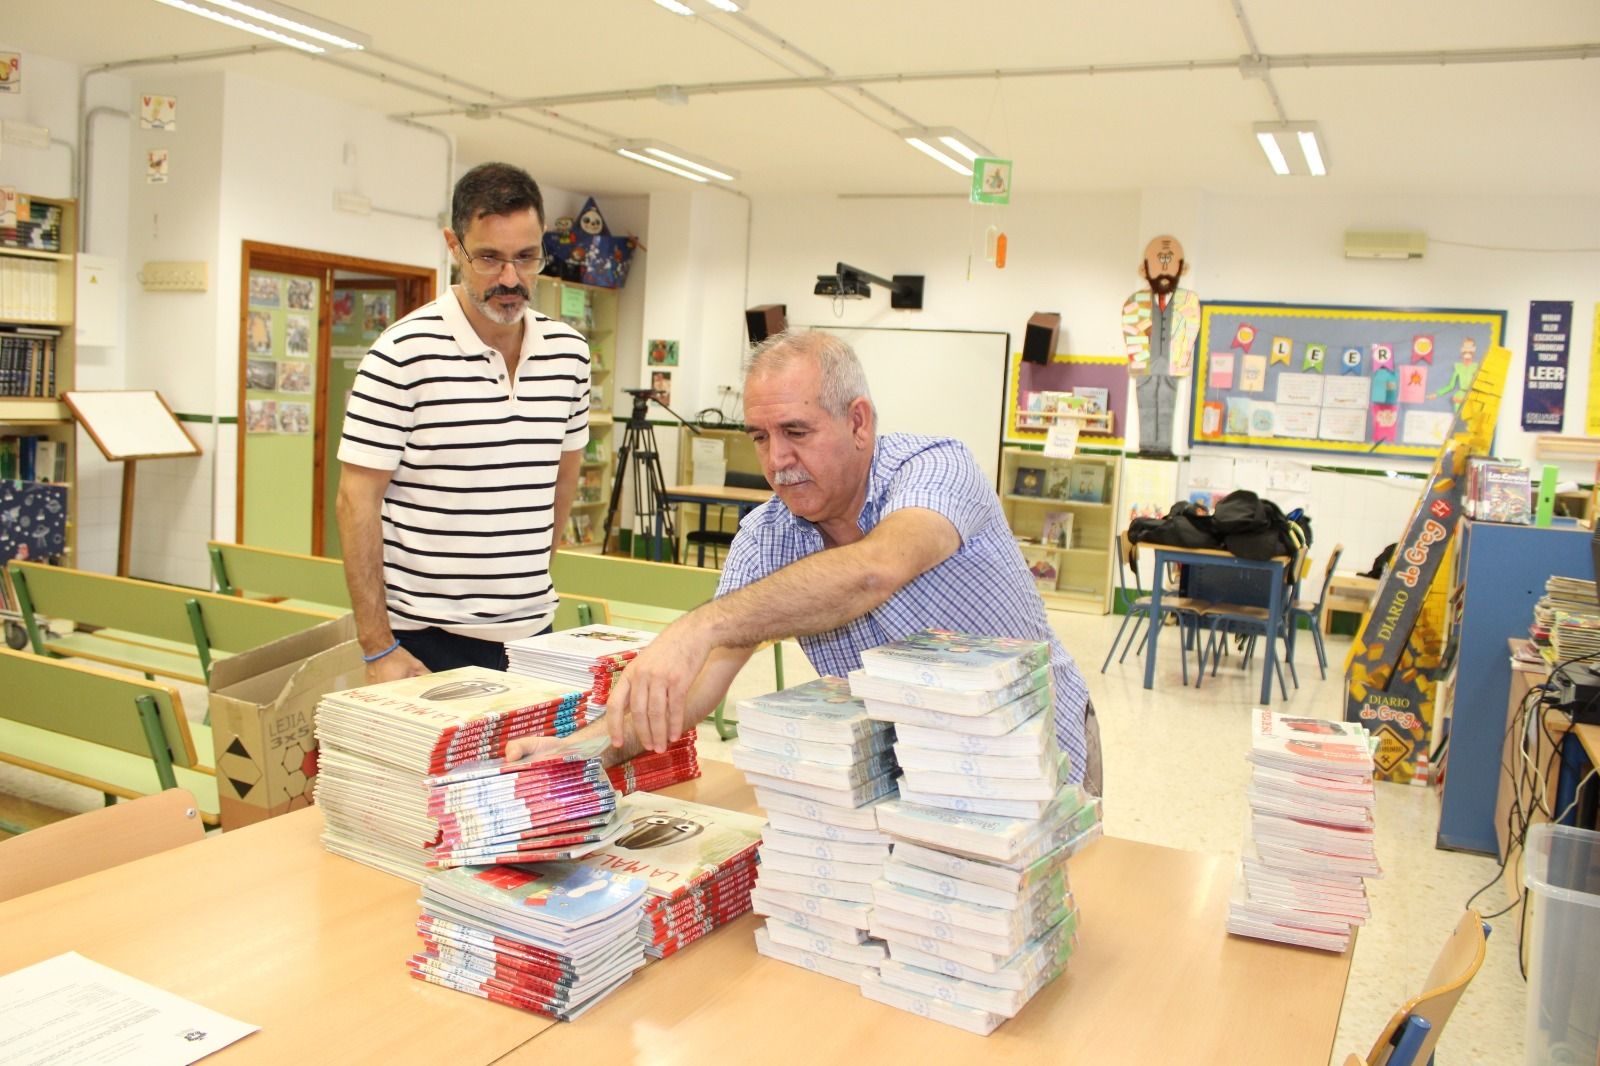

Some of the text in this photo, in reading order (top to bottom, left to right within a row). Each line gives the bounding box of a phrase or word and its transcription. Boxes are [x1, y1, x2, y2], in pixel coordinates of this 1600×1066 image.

[1529, 366, 1565, 381] LEER
[1377, 499, 1451, 642] DIARIO de Greg 14
[1368, 695, 1410, 708] DIARIO
[268, 711, 306, 737] LEJIA
[1360, 703, 1378, 720] de
[1378, 705, 1415, 729] Greg
[580, 852, 650, 875] MALA
[647, 868, 680, 883] LA
